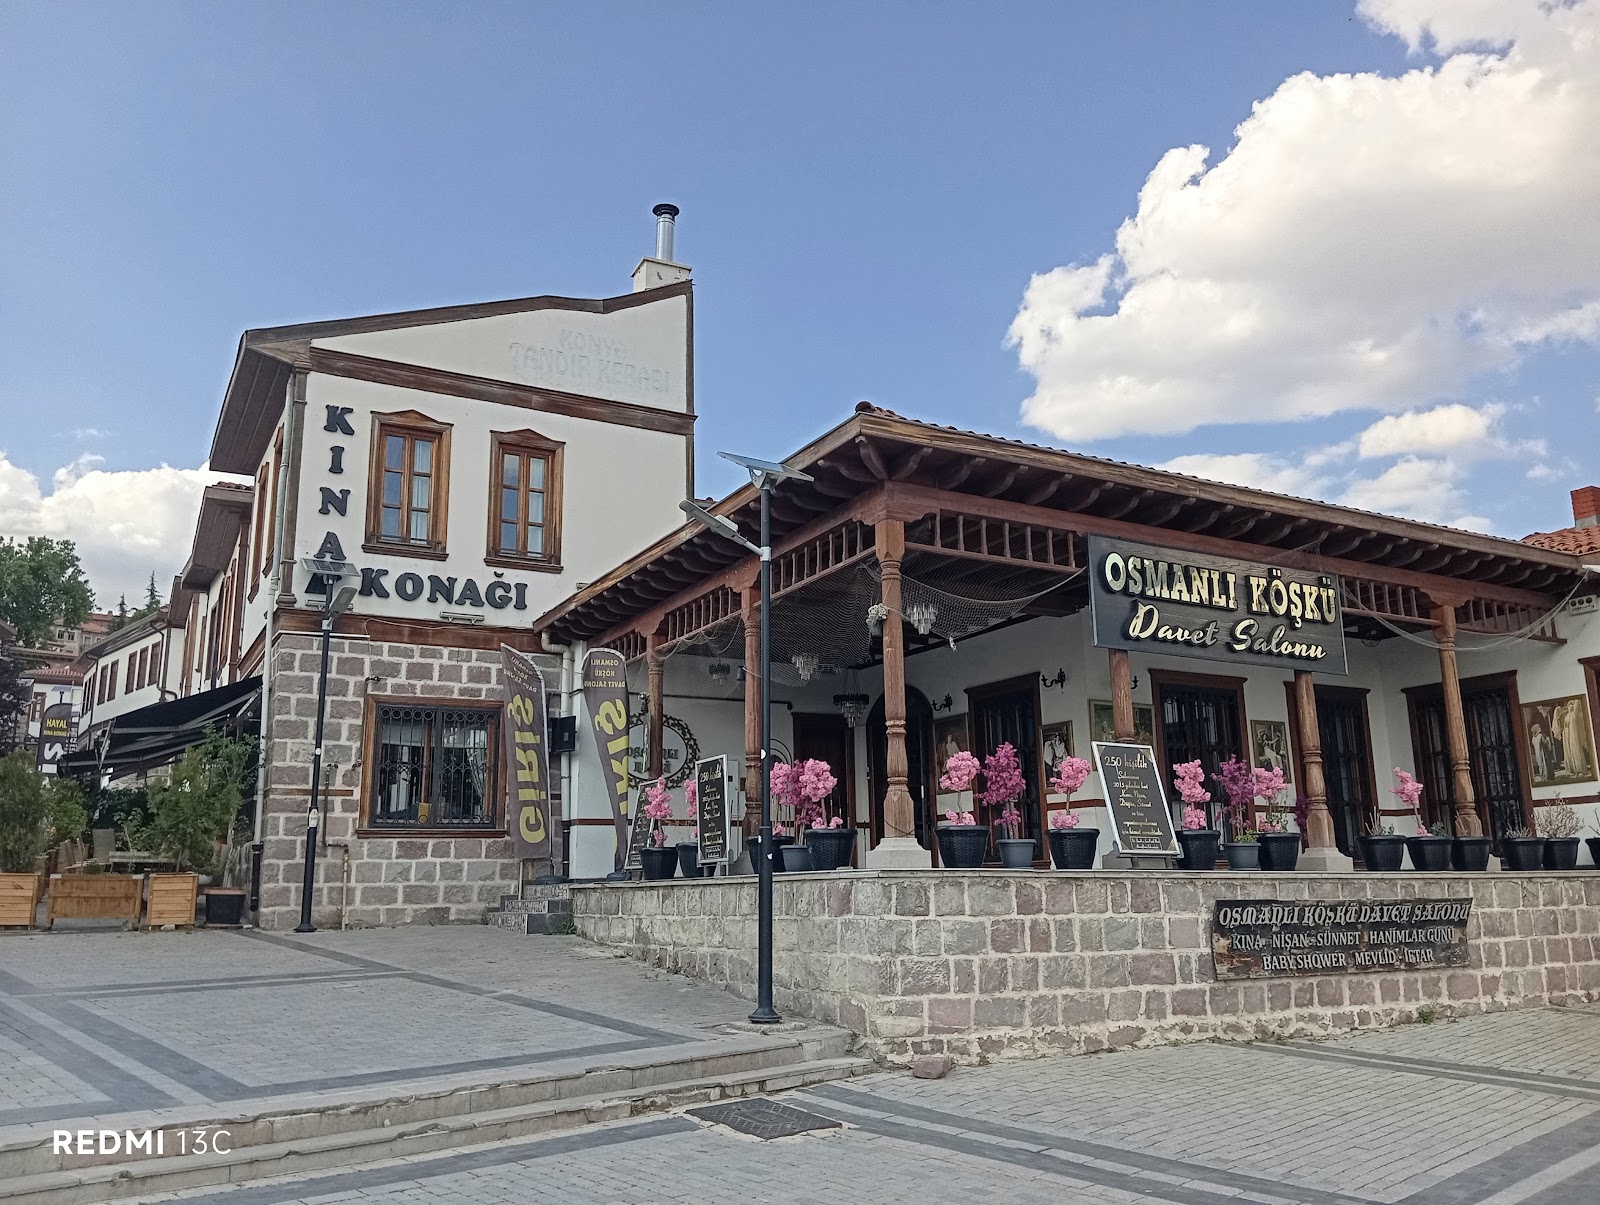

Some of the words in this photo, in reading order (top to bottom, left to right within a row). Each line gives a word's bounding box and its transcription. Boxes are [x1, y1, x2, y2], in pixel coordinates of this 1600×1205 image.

[358, 567, 528, 610] KONAĞI
[1103, 551, 1238, 610] OSMANLI
[1246, 567, 1336, 629] KÖŞKÜ
[1128, 602, 1219, 647] Davet
[1230, 618, 1327, 660] Salonu
[46, 718, 68, 728] HAYAL
[1104, 756, 1122, 767] 250
[1124, 753, 1148, 770] kişilik
[1218, 904, 1301, 928] OSMANLI
[1302, 902, 1359, 926] KÖŞKÜ
[1358, 904, 1412, 923] DAVET
[1412, 903, 1471, 923] SALONU
[1232, 933, 1263, 950] KINA
[1316, 930, 1361, 947] SÜNNET
[1263, 954, 1296, 970] BABY
[1296, 953, 1347, 969] SHOWER
